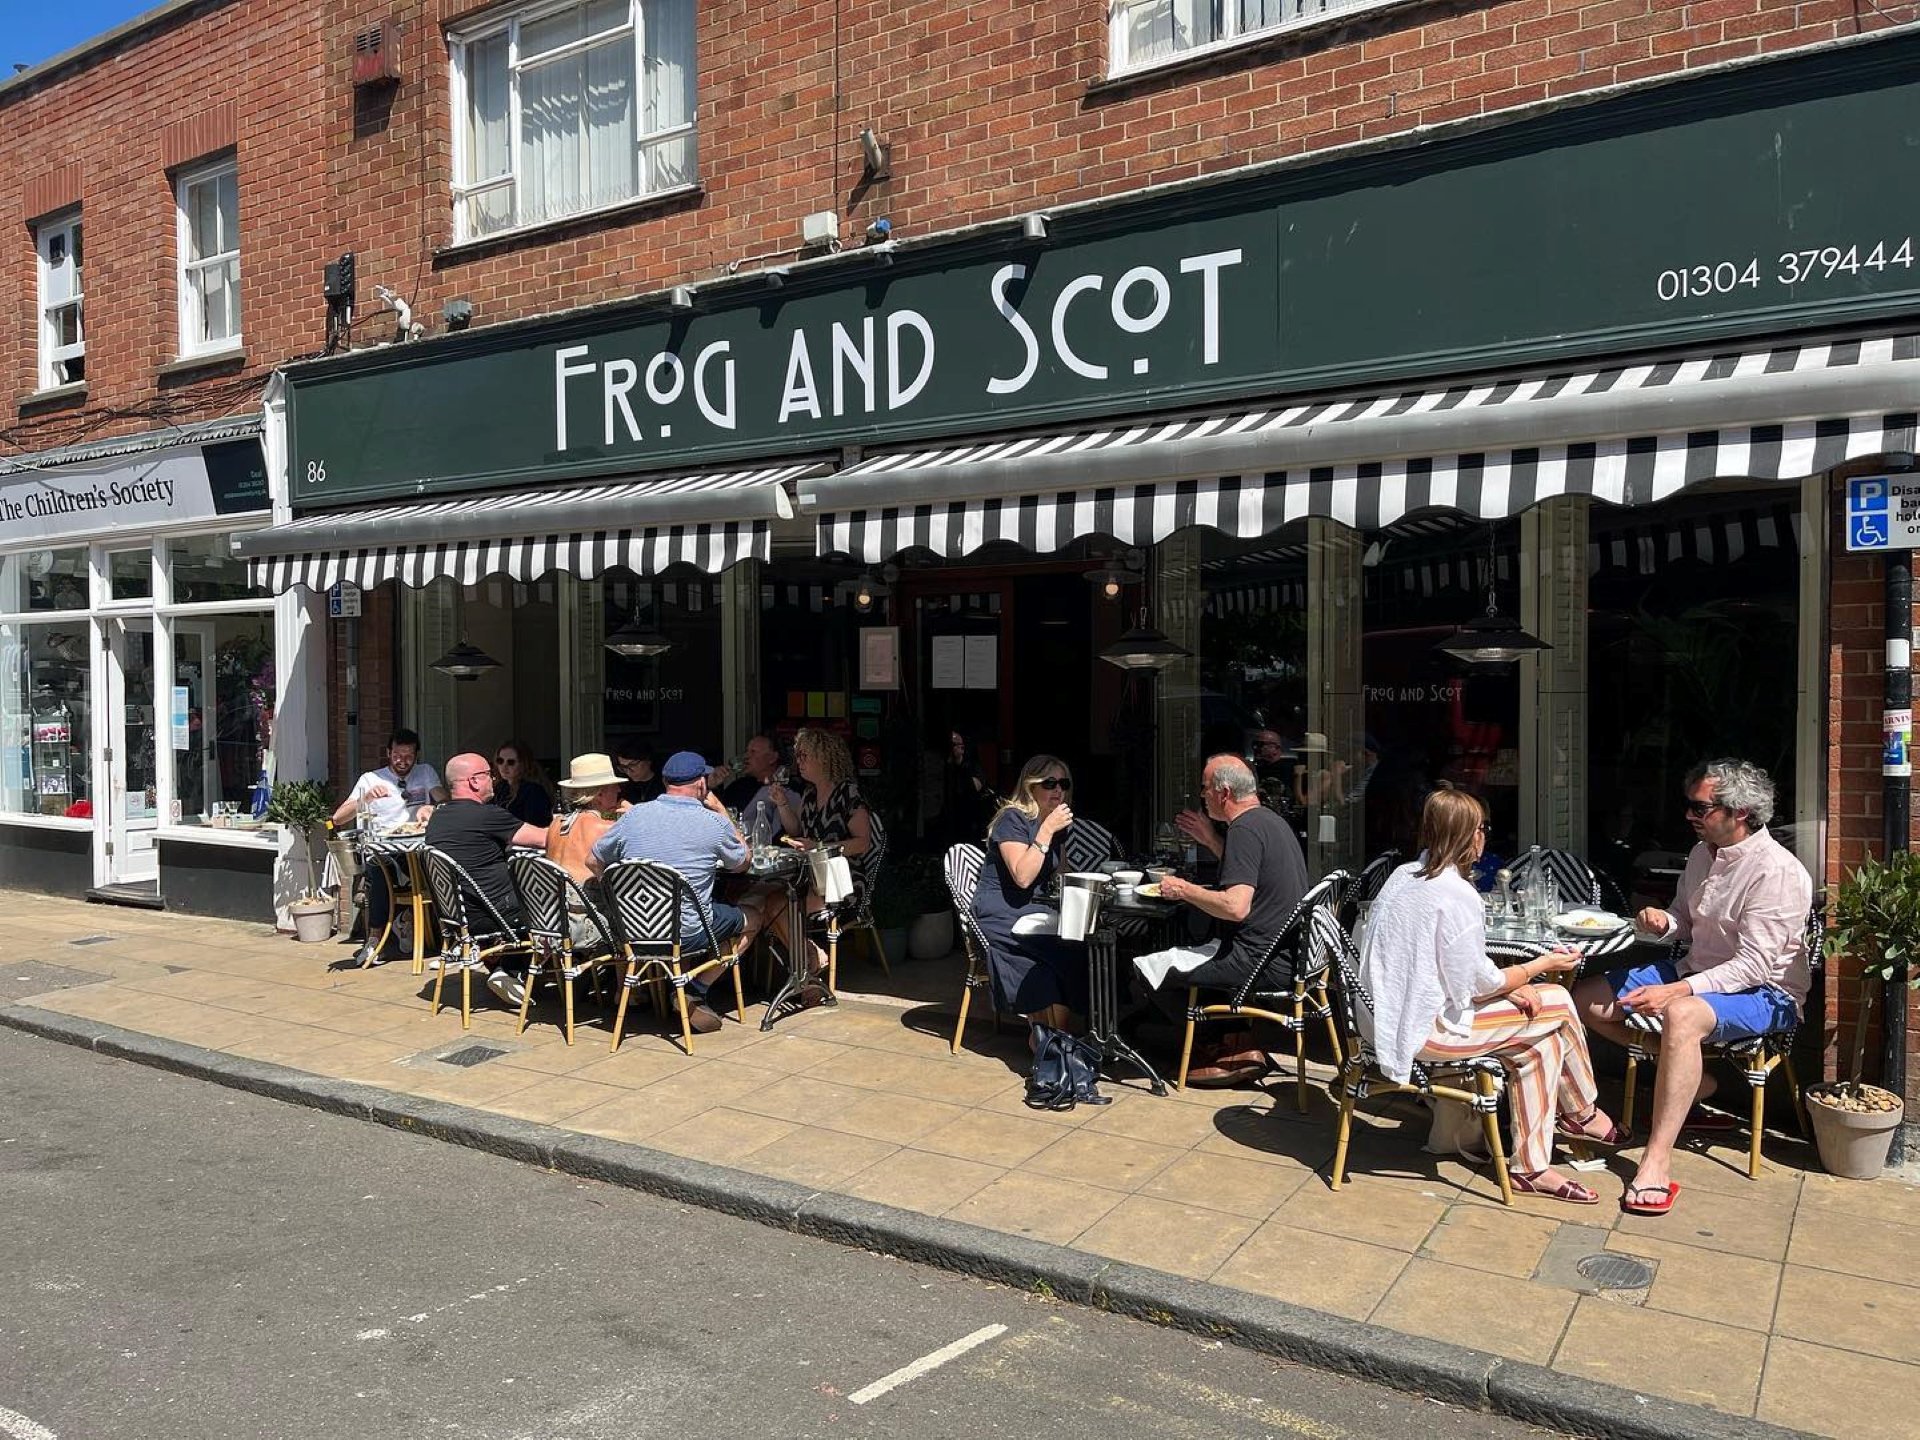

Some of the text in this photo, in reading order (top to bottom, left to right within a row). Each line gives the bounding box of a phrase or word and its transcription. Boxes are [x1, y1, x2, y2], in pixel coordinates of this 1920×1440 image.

[1657, 236, 1915, 301] 01304 379444
[555, 248, 1242, 451] FROG AND SCOT
[307, 460, 326, 483] 86
[0, 477, 174, 521] The Children's Society
[1860, 482, 1882, 509] P
[1900, 498, 1920, 509] ba
[1400, 687, 1425, 701] AND
